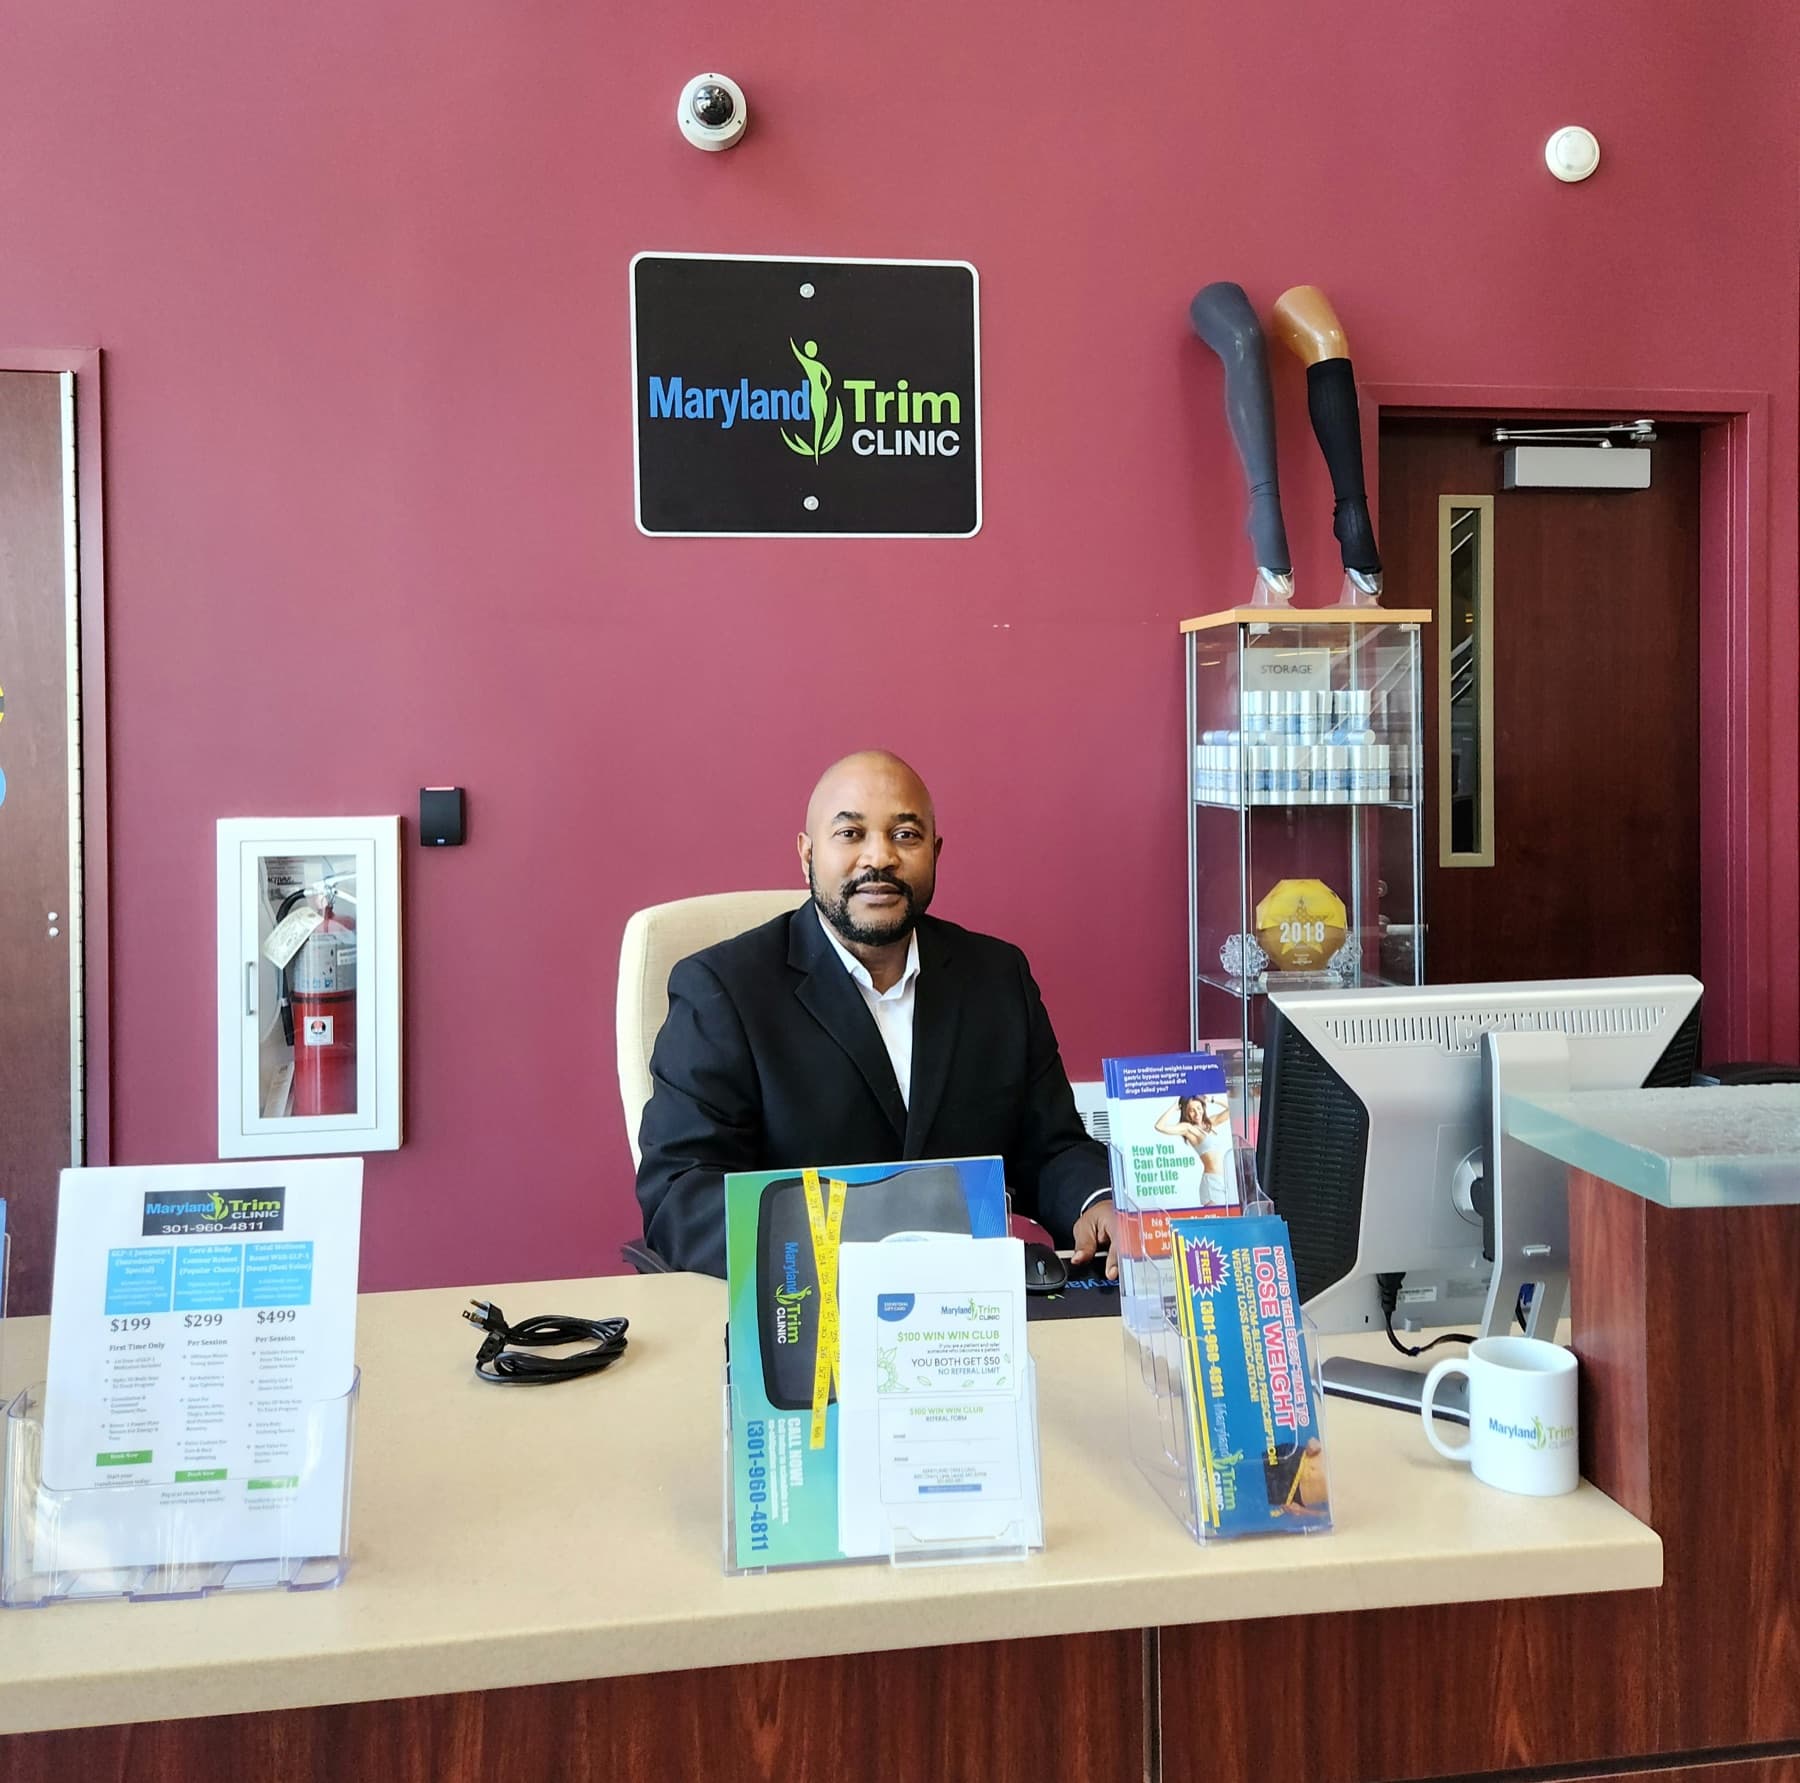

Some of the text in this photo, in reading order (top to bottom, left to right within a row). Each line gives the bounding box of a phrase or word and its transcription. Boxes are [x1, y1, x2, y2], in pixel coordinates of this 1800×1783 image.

[649, 376, 960, 429] Maryland Trim
[852, 429, 960, 456] CLINIC
[1260, 664, 1313, 675] STORAGE
[1280, 921, 1325, 943] 2018
[1138, 1066, 1164, 1074] traditional
[1155, 1144, 1174, 1155] You
[1133, 1156, 1195, 1170] Can Change
[1134, 1170, 1179, 1182] Your Life
[1136, 1184, 1178, 1197] Forever.
[146, 1199, 281, 1216] Maryland Trim
[231, 1210, 280, 1220] CLINIC
[1151, 1218, 1163, 1226] No
[162, 1221, 264, 1234] 301-960-4811
[1200, 1250, 1212, 1284] FREE
[1232, 1248, 1245, 1294] WEIGHT
[784, 1241, 801, 1344] Maryland Trim
[941, 1306, 1000, 1316] Maryland Trim
[1238, 1295, 1249, 1324] LOSS
[110, 1310, 296, 1332] $199 $299 $499
[776, 1307, 786, 1344] CLINIC
[201, 1338, 228, 1346] Session
[897, 1330, 1000, 1342] $100 WIN WIN CLUB
[1252, 1246, 1296, 1430] LOSE WEIGHT
[1274, 1246, 1310, 1427] NOW IS THE BEST TIME TO
[109, 1344, 126, 1352] First
[148, 1342, 166, 1350] Only
[964, 1342, 980, 1350] patient
[984, 1346, 1000, 1354] patient
[912, 1356, 1000, 1368] YOU BOTH GET $50
[1241, 1248, 1278, 1466] NEW CUSTOM-BLENDED PRESCRIPTION
[938, 1368, 949, 1376] NO
[982, 1366, 1000, 1374] LIMIT
[946, 1406, 961, 1414] WIN
[962, 1406, 984, 1414] CLUB
[1489, 1417, 1574, 1439] Maryland Trim
[788, 1417, 804, 1486] CALL NOW!
[1214, 1403, 1237, 1510] Maryland Trim
[1214, 1472, 1224, 1511] CLINIC
